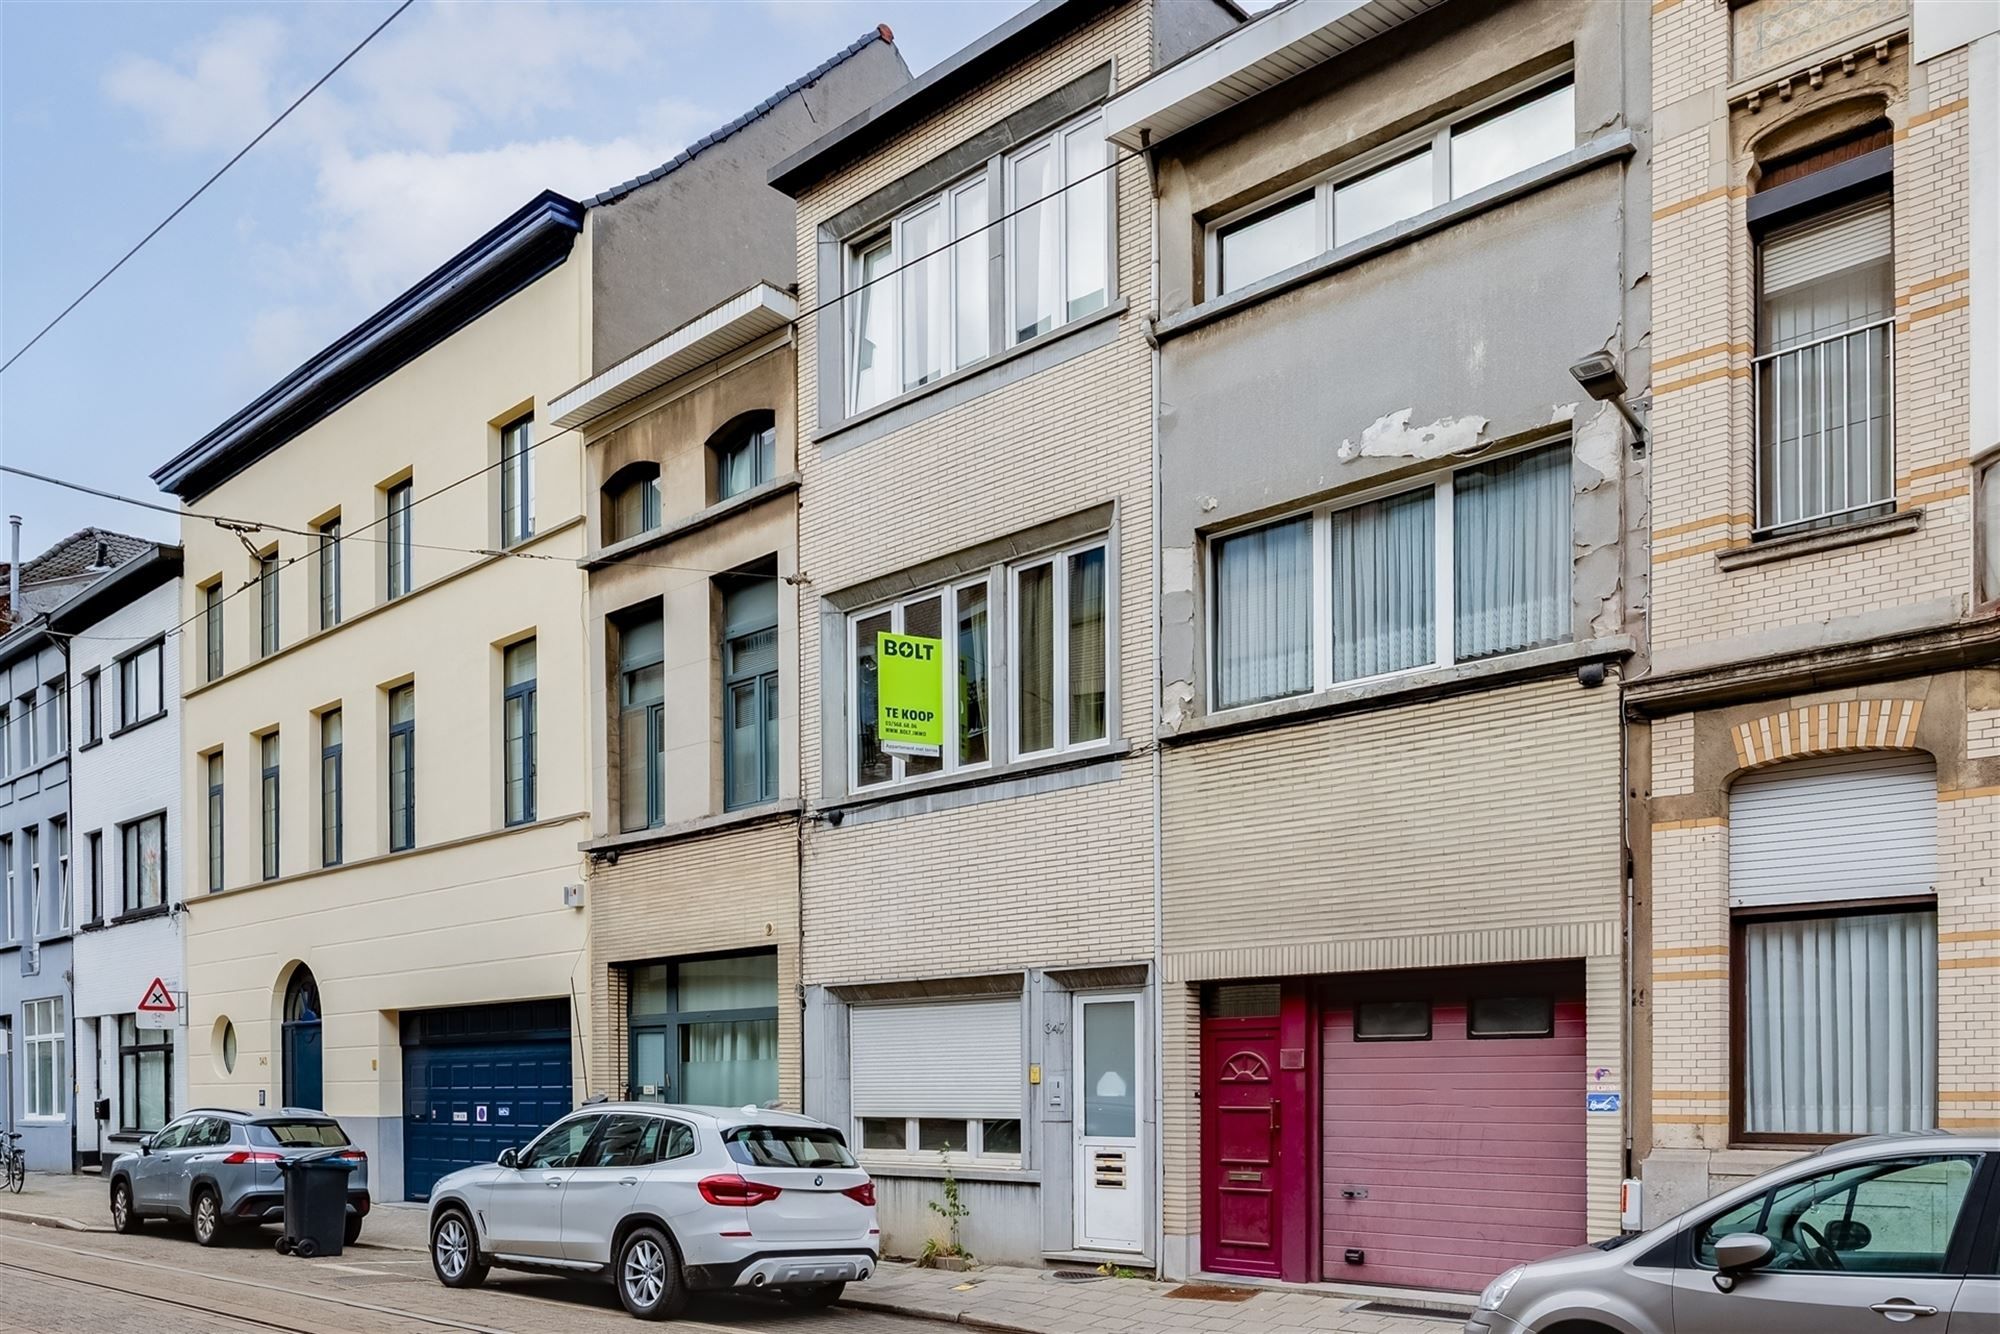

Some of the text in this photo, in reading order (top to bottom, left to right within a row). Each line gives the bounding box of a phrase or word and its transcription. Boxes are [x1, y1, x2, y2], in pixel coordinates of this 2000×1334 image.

[884, 639, 934, 660] BOLT
[885, 707, 934, 722] TE KOOP
